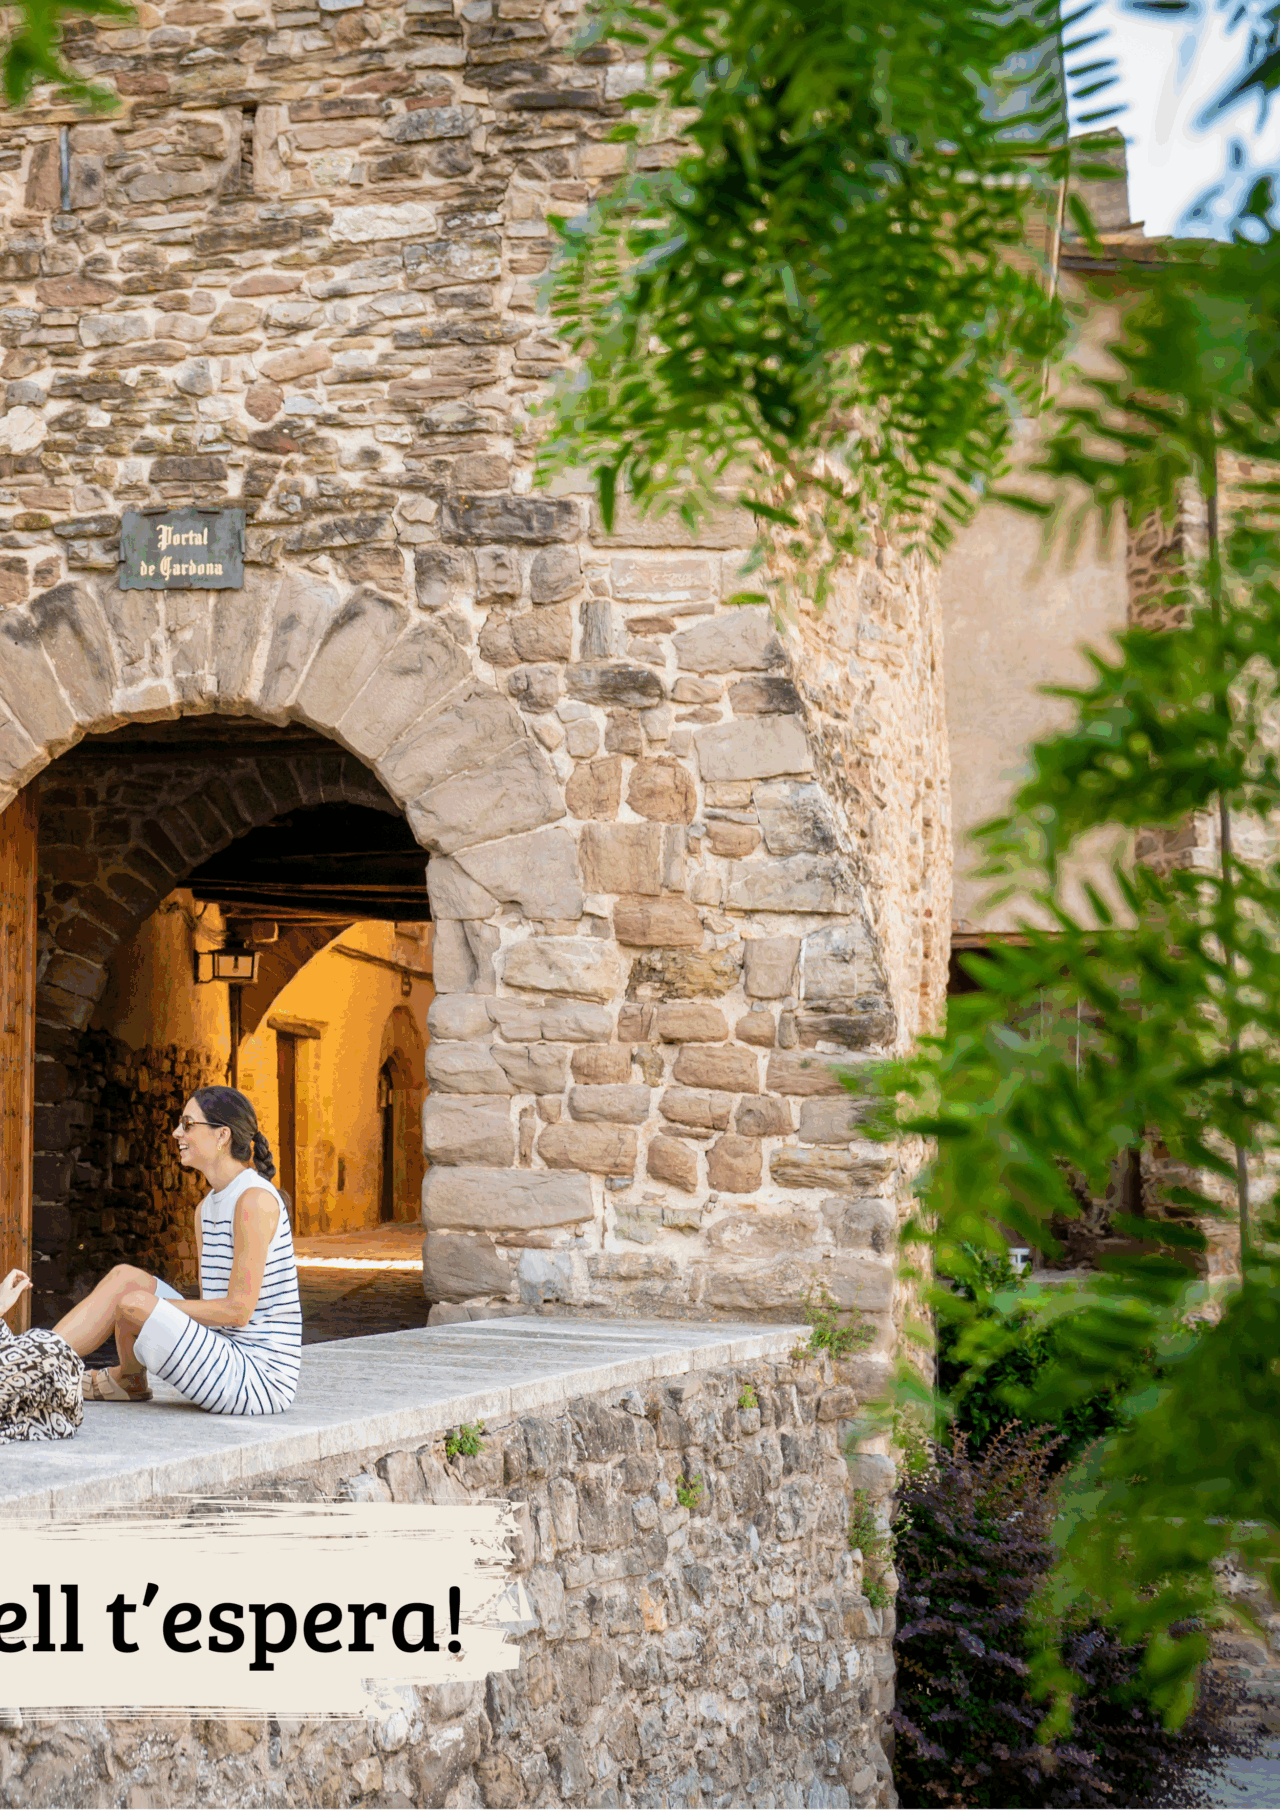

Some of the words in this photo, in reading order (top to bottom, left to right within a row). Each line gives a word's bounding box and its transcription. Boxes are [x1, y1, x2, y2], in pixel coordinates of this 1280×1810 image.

[156, 524, 208, 551] Portal
[140, 560, 156, 576] de
[159, 555, 224, 581] Cardona
